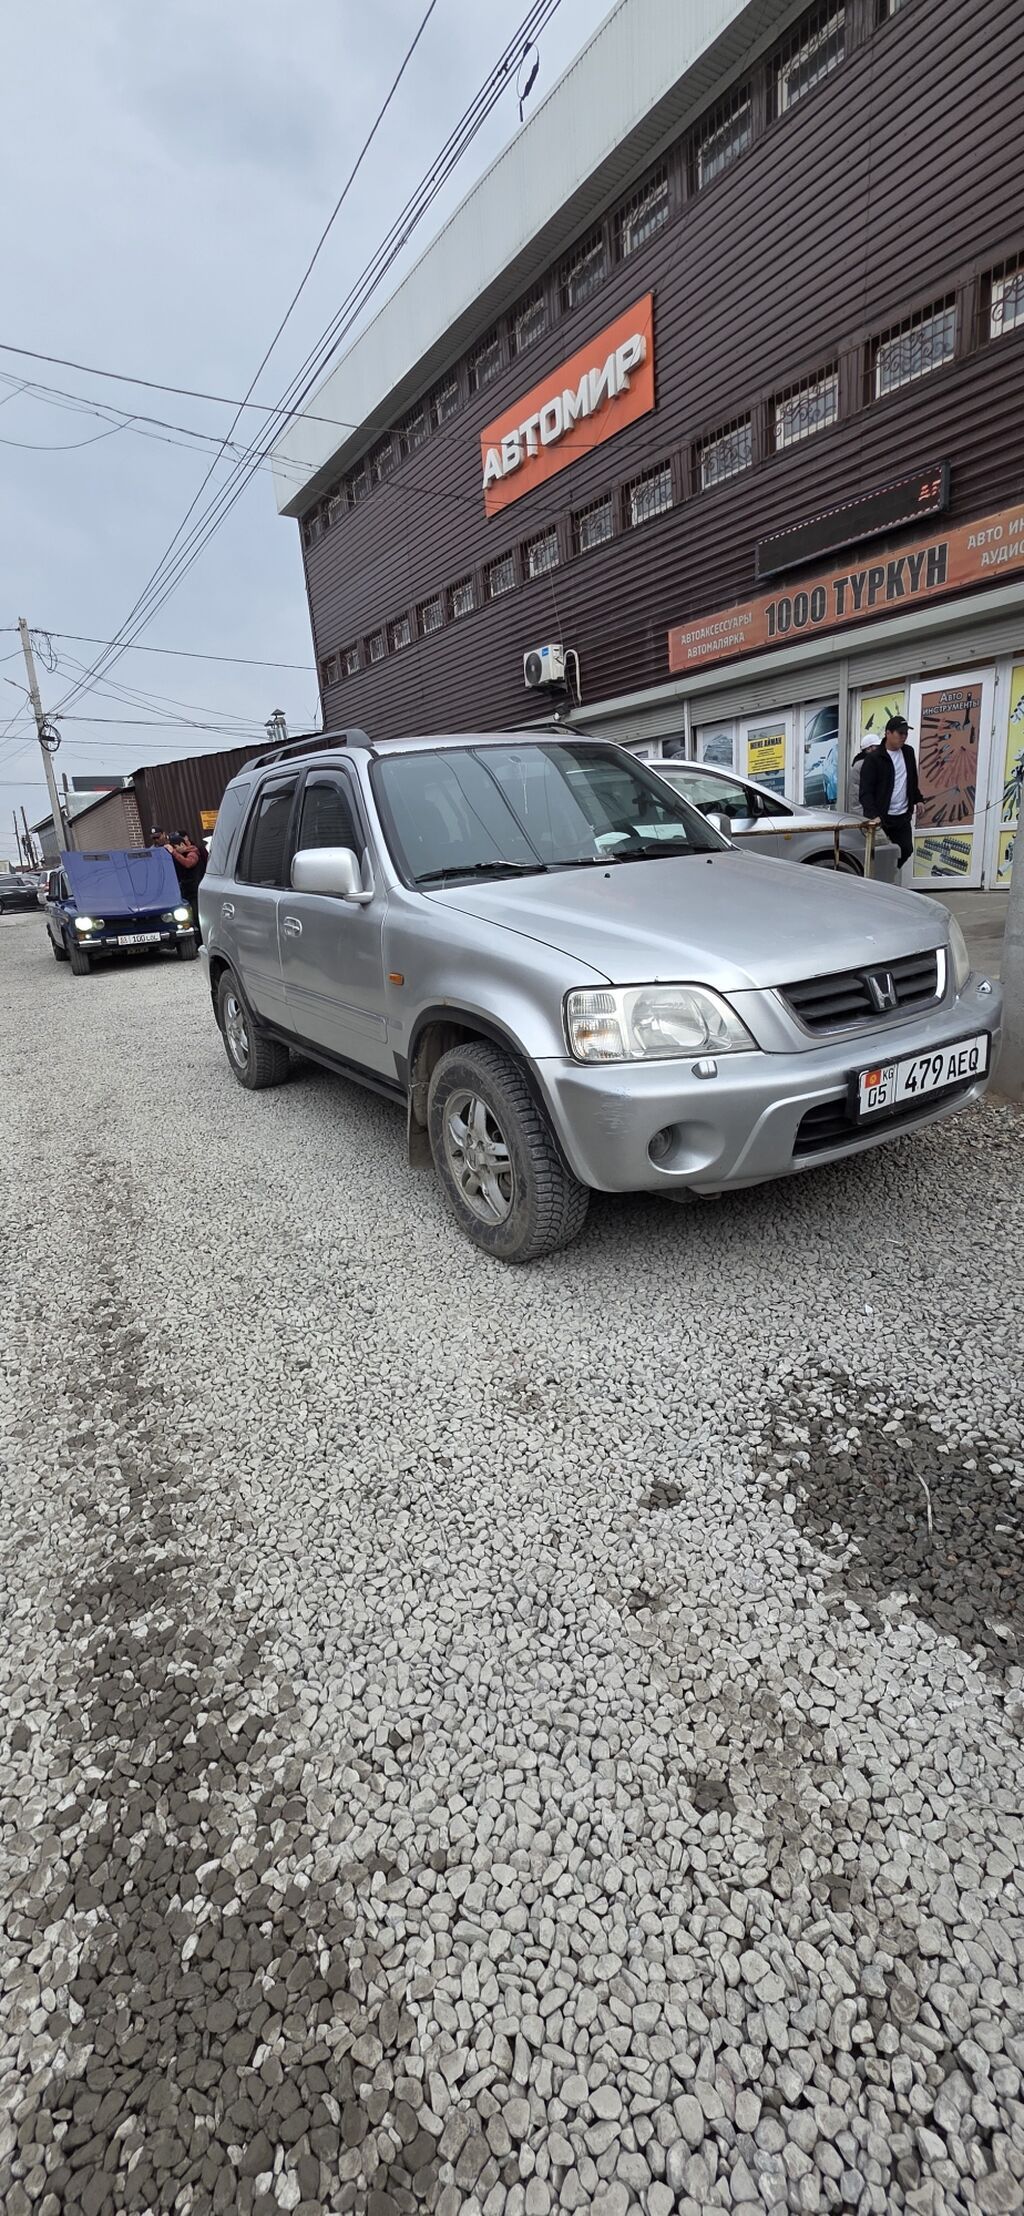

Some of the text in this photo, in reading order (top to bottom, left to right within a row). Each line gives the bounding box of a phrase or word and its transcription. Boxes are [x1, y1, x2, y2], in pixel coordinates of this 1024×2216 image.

[482, 333, 646, 489] АВТОМИР
[967, 525, 1003, 550] АВТО
[765, 585, 828, 637] 1000
[681, 612, 752, 645] АВТОАКСЕССУАРЫ
[687, 632, 745, 659] АВТОМАЛЯРКА
[882, 1068, 894, 1081] KG
[905, 1047, 979, 1092] 479 AEQ
[868, 1084, 887, 1108] 05
